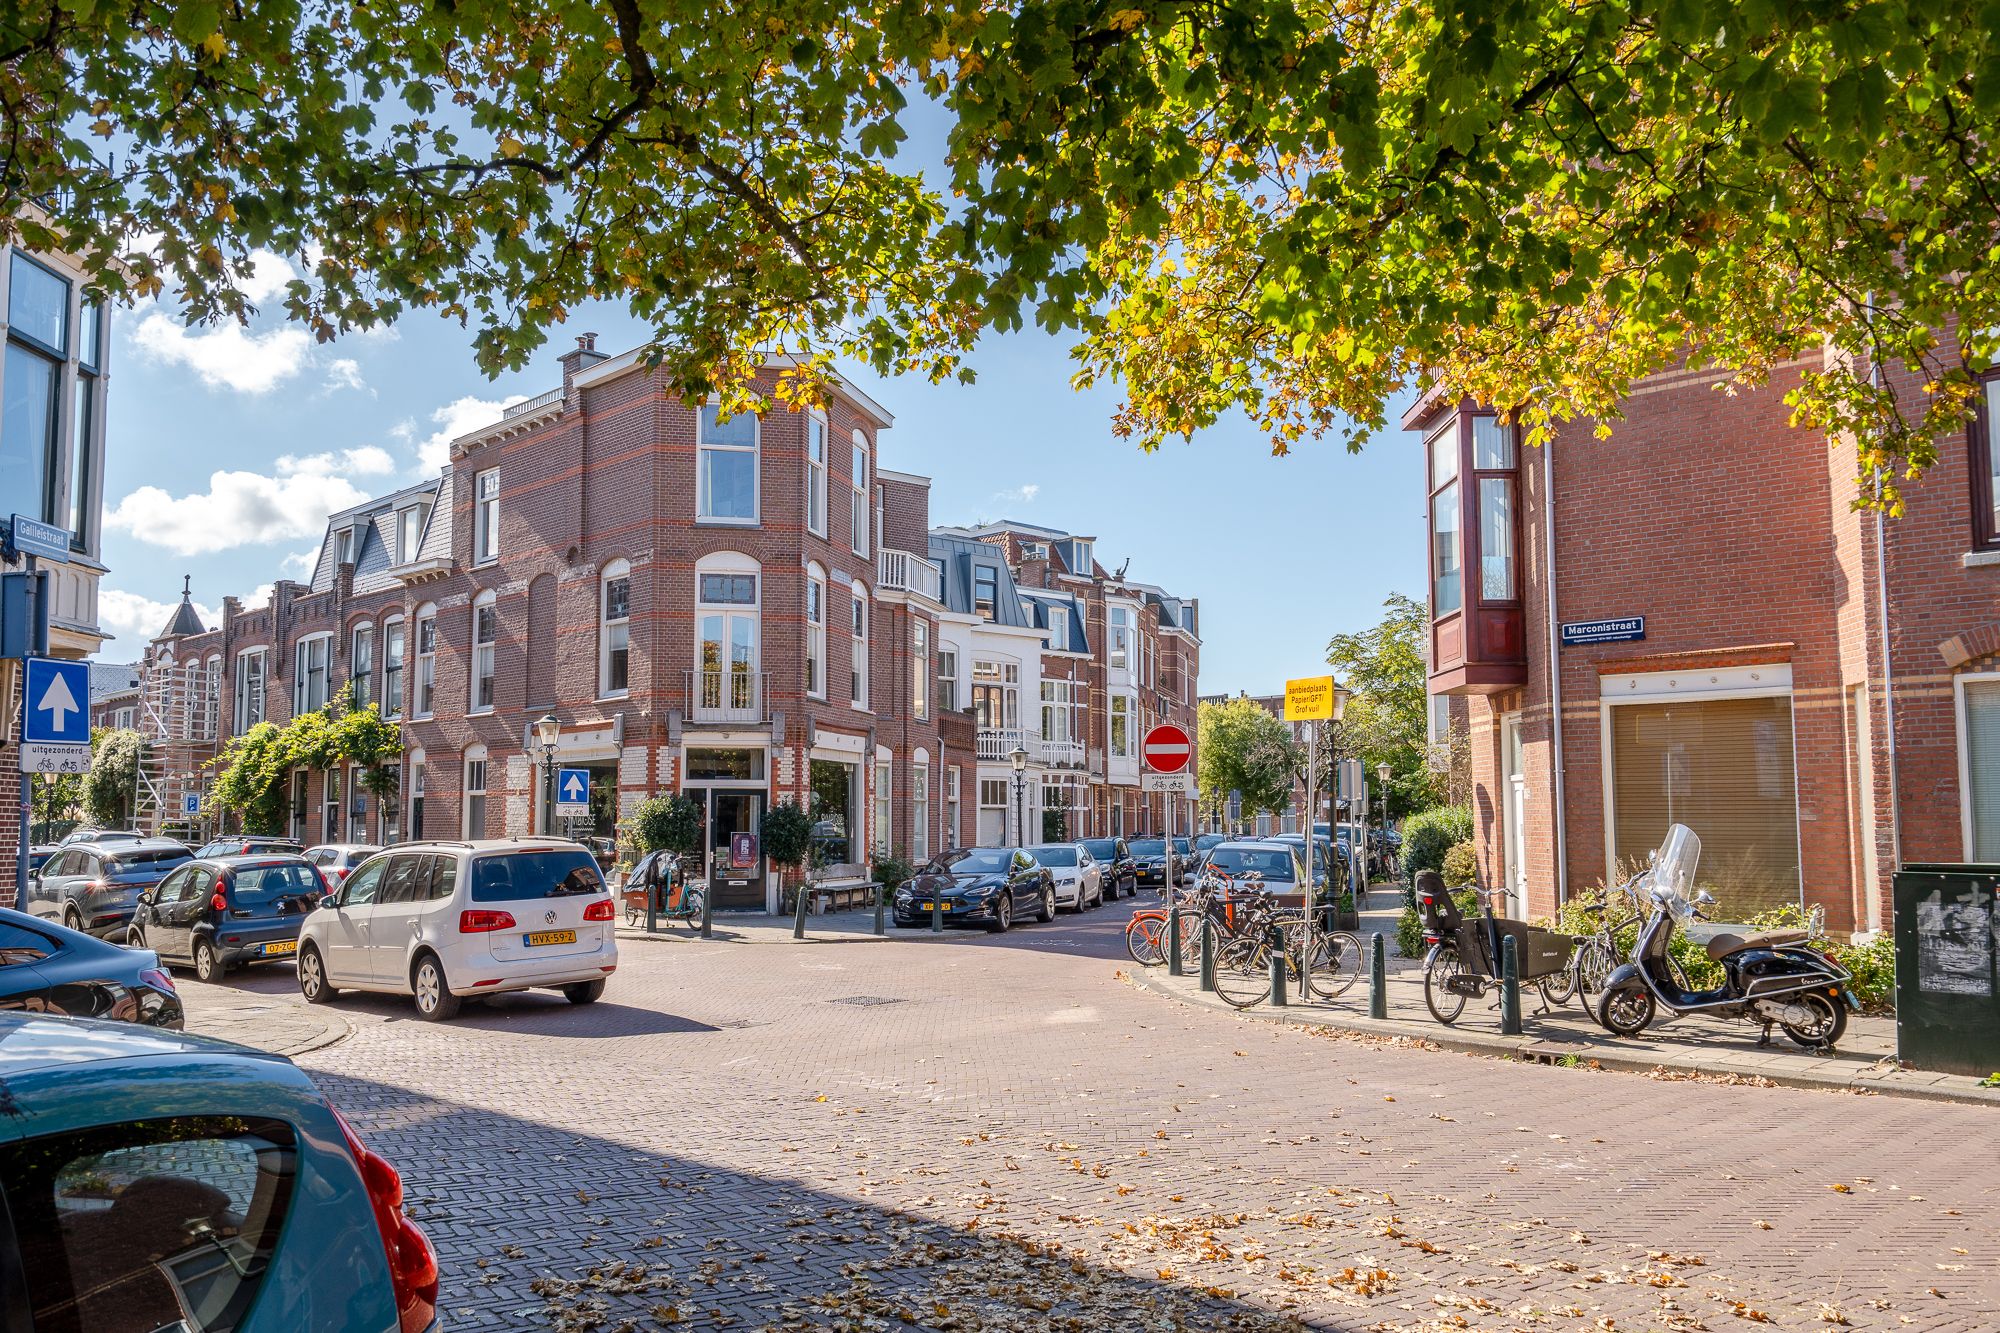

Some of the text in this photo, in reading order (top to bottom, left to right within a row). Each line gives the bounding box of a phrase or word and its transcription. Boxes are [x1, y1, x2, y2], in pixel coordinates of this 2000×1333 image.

[1568, 620, 1637, 635] Marconistraat
[1288, 684, 1327, 695] aanbiedplaats
[1295, 704, 1320, 714] Grof vuil
[31, 745, 83, 755] uitgezonderd
[563, 813, 596, 826] SMBIOSE
[532, 933, 573, 945] HVX-59-Z
